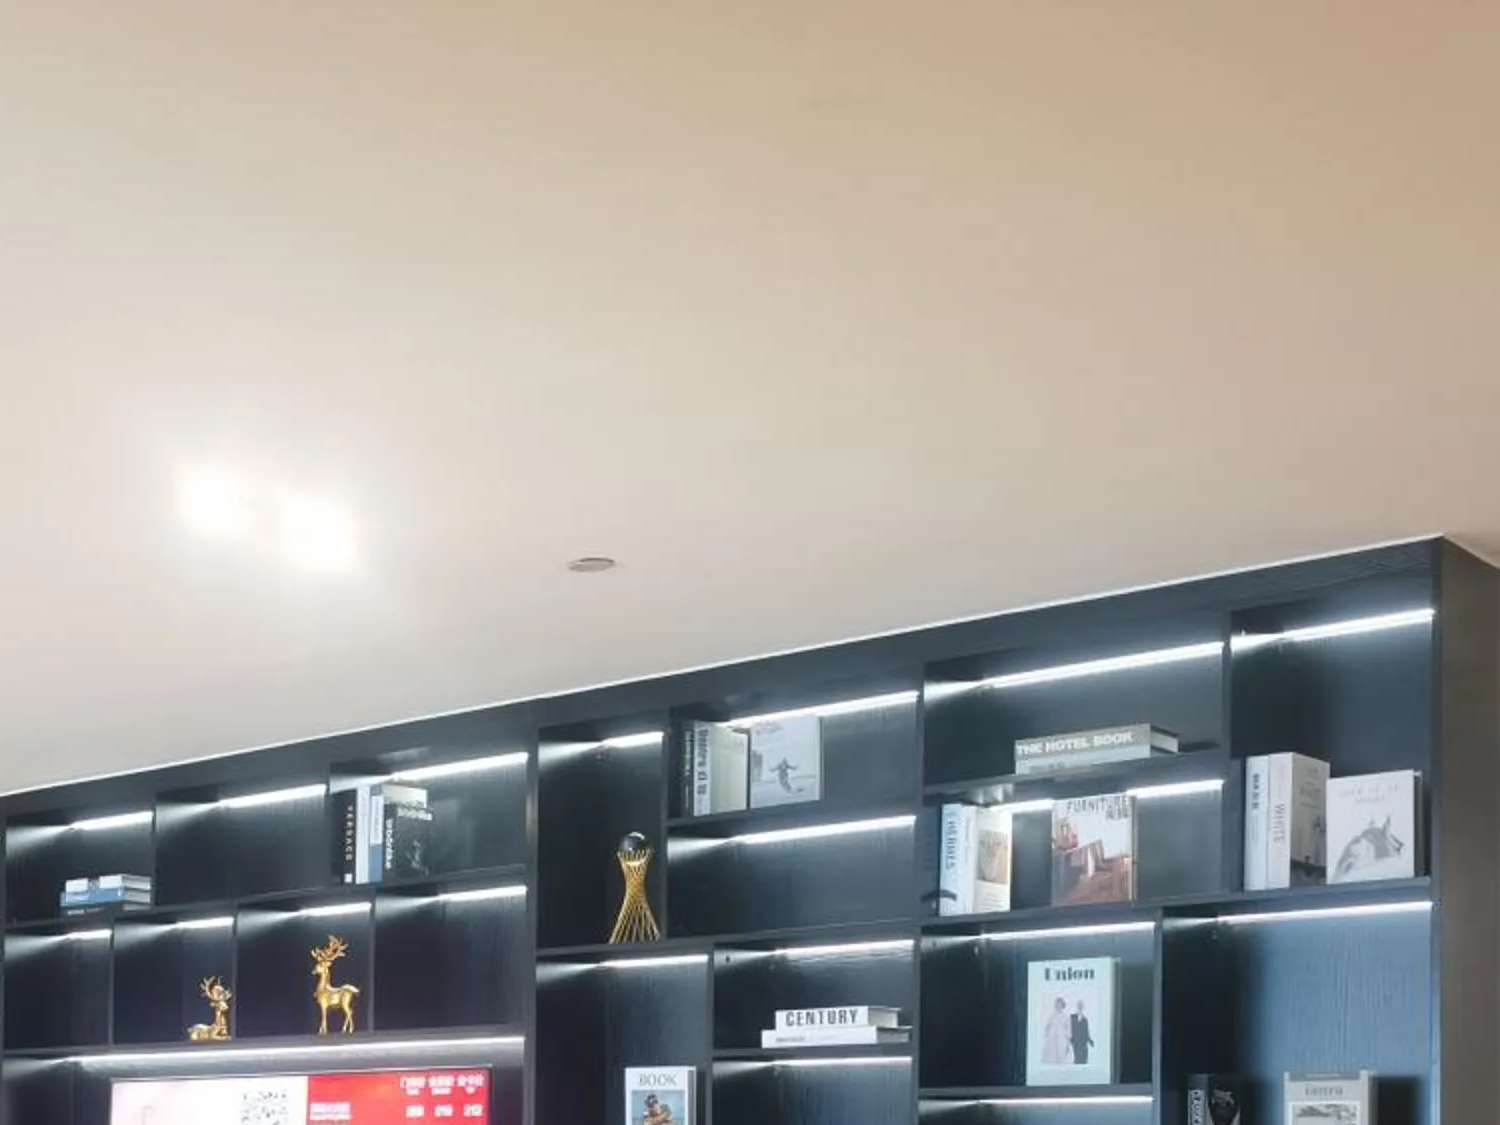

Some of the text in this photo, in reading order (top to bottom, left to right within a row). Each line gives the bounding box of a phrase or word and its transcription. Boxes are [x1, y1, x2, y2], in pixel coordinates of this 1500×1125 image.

[1016, 731, 1134, 756] THE HOTEL BOOK
[785, 1007, 859, 1027] CENTURY
